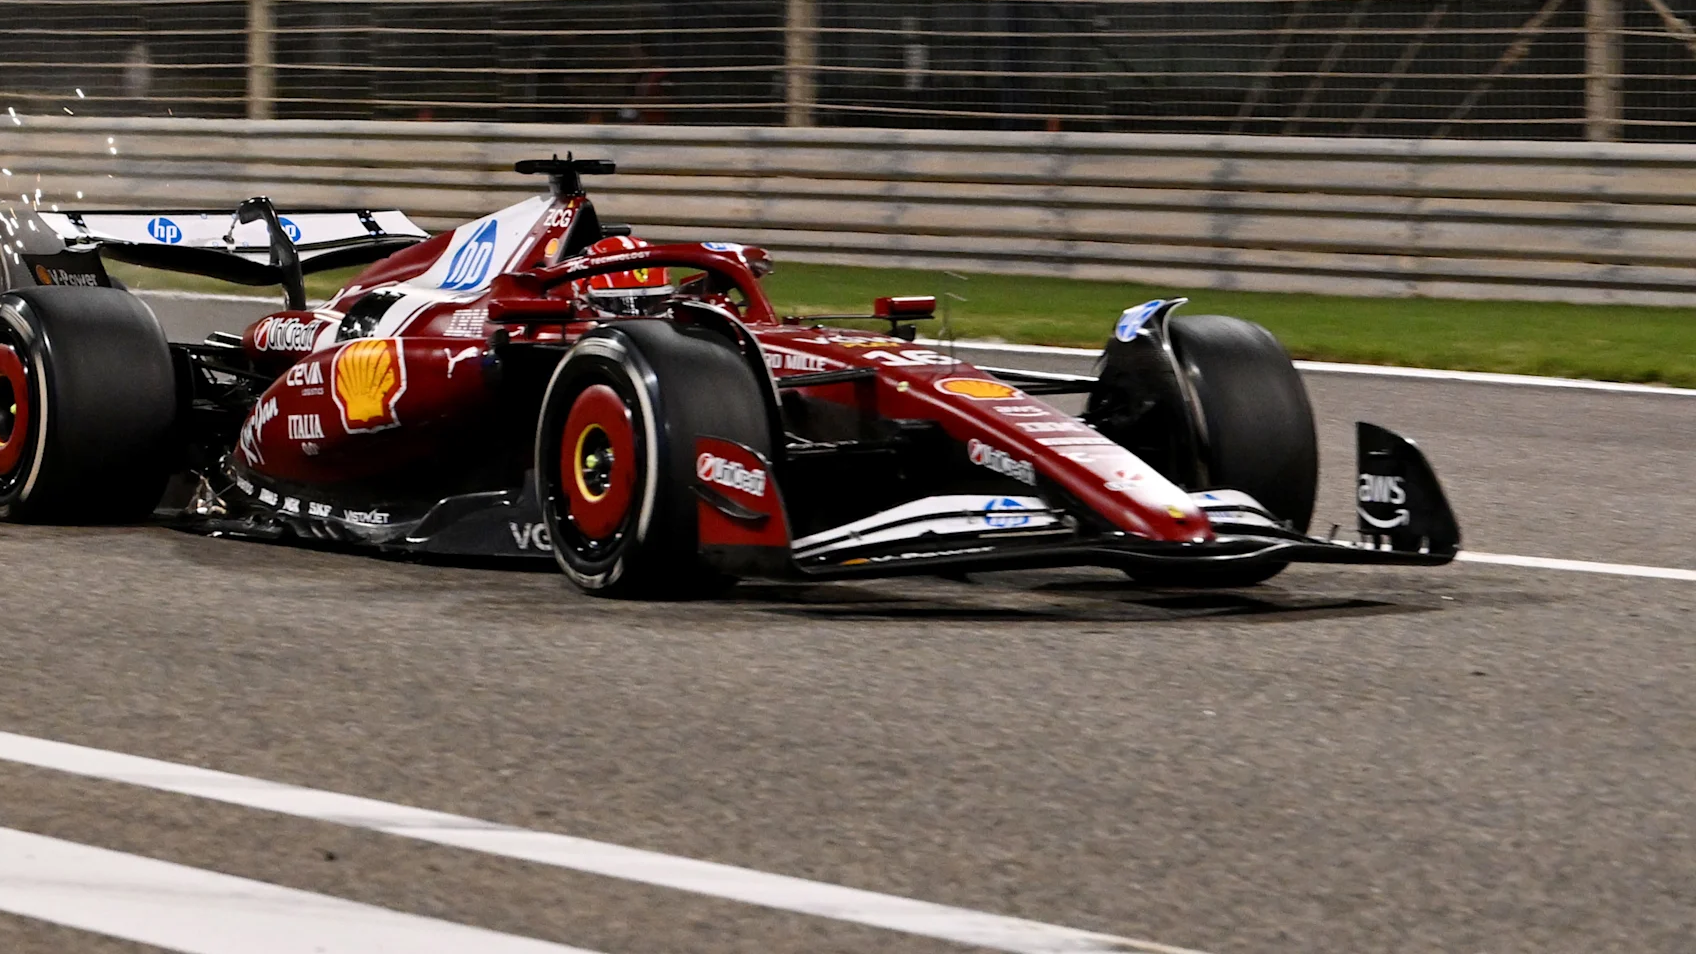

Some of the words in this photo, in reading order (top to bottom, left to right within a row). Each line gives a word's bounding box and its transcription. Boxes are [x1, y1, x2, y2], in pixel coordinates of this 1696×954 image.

[543, 208, 573, 228] ZCG
[151, 218, 180, 244] hp
[590, 251, 651, 265] TECHNOLOGY
[47, 268, 98, 286] V-Power
[268, 317, 324, 352] UniCredit
[785, 353, 827, 372] MILLE
[862, 350, 962, 366] 16
[288, 413, 325, 439] ITALIA
[1359, 473, 1406, 505] aws
[308, 502, 332, 517] SKF
